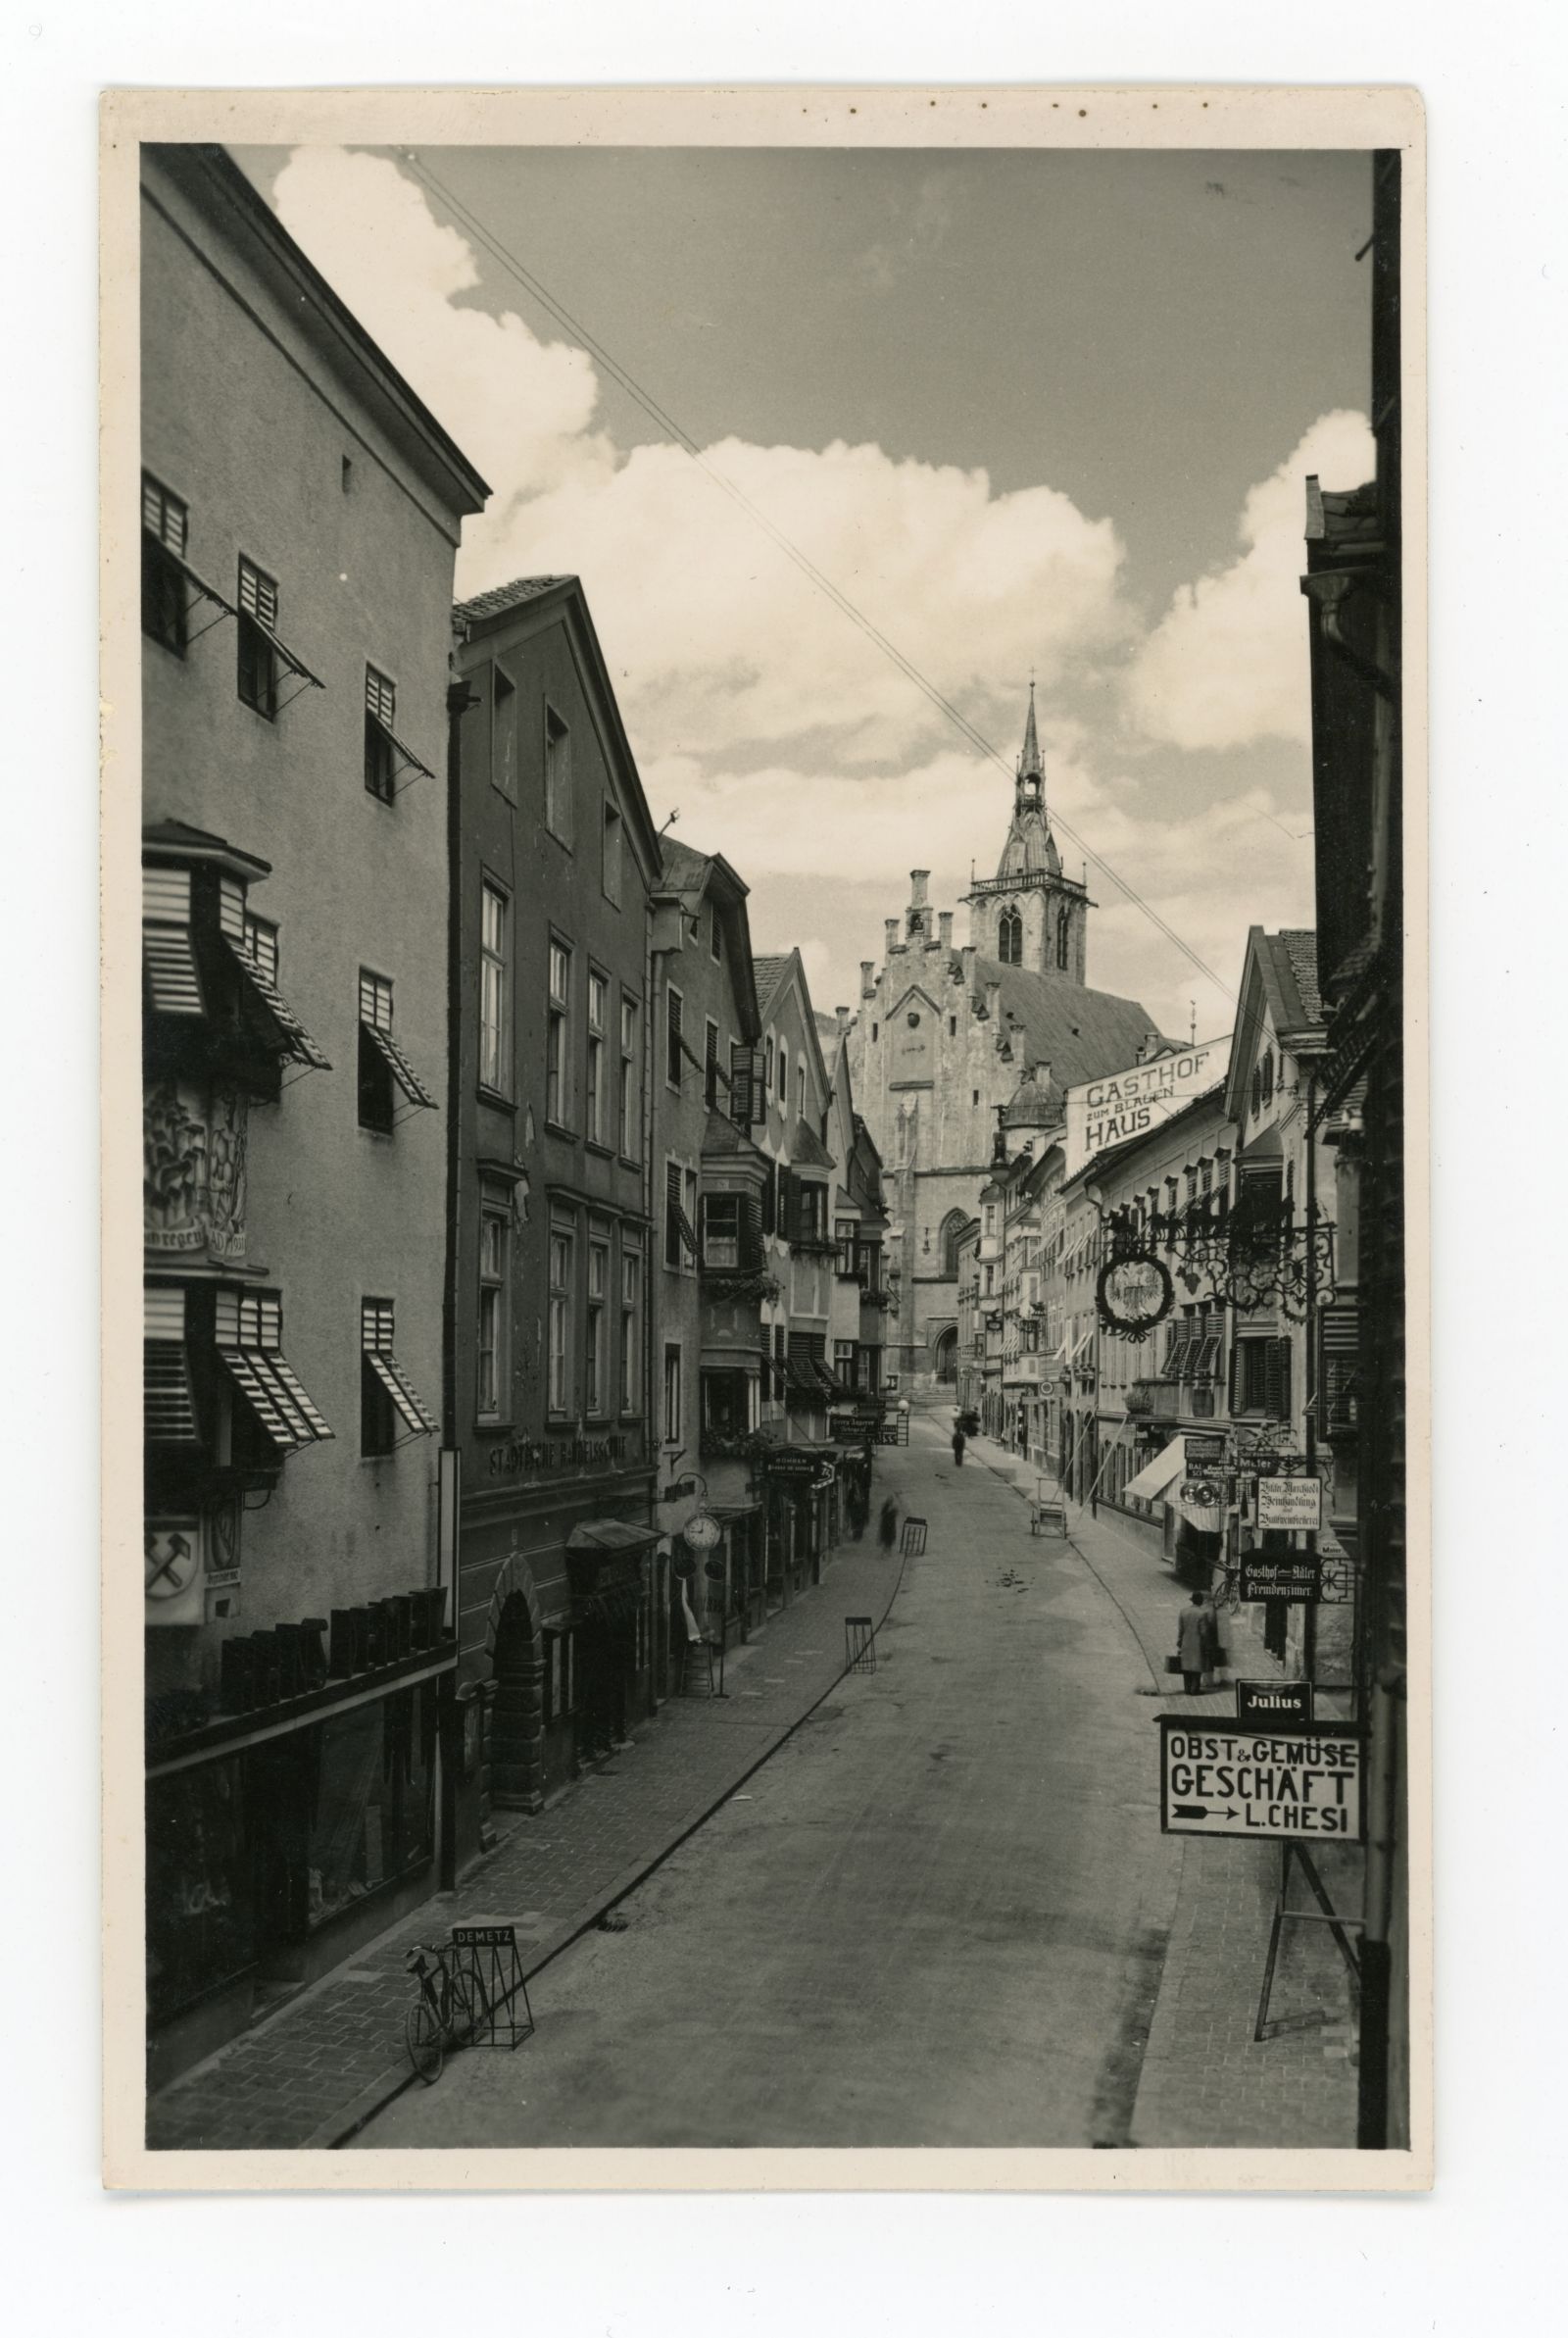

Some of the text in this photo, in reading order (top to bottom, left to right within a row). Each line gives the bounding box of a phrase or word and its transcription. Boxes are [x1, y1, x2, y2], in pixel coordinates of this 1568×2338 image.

[1086, 1051, 1210, 1109] GASTHOF
[1086, 1109, 1109, 1121] ZUM
[1085, 1107, 1151, 1152] HAUS
[1246, 1564, 1316, 1580] Gasthof Adler
[1247, 1695, 1302, 1710] Julius
[1170, 1736, 1356, 1767] OBST & GEMÜSE
[1171, 1764, 1354, 1806] GESCHÄFT
[458, 1930, 512, 1943] DEMETZ
